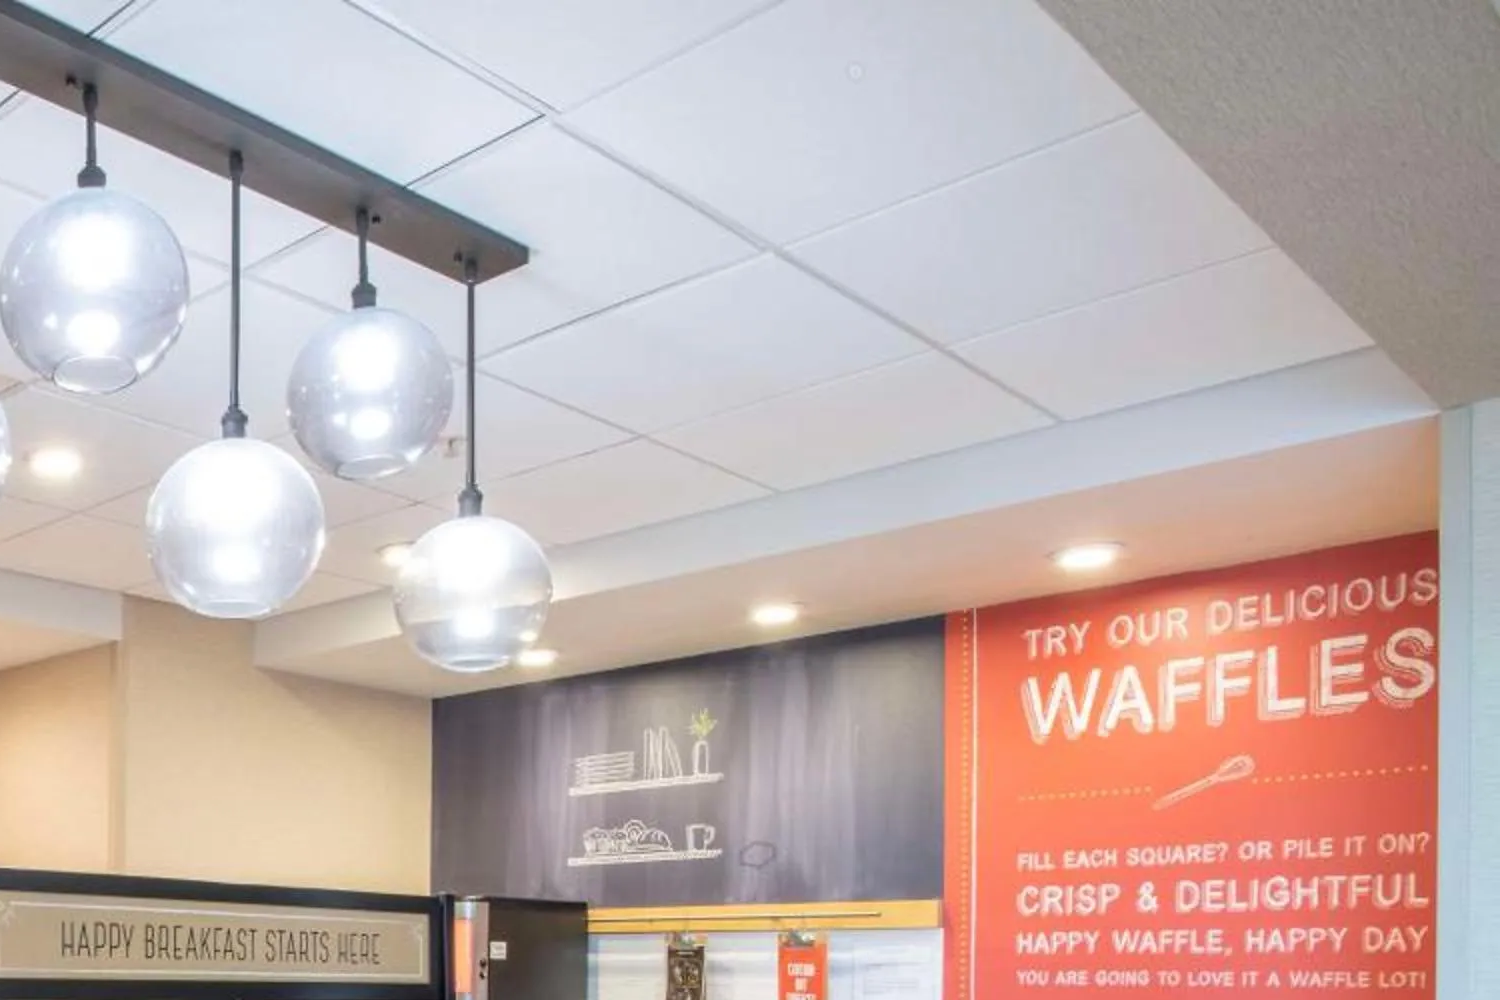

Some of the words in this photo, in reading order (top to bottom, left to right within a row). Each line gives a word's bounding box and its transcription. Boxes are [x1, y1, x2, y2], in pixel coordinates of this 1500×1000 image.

[1020, 620, 1092, 661] TRY
[1107, 606, 1189, 649] OUR
[1205, 567, 1438, 636] DELICIOUS
[1020, 627, 1436, 746] WAFFLES
[1016, 852, 1056, 872] FILL
[1062, 848, 1118, 868] EACH
[1126, 842, 1229, 867] SQUARE?
[1238, 840, 1273, 861] OR
[1283, 836, 1333, 859] PILE
[1344, 835, 1367, 856] IT
[1378, 831, 1430, 855] ON?
[1016, 883, 1121, 917] CRISP
[1135, 880, 1159, 914] &
[1175, 872, 1430, 914] DELIGHTFUL
[61, 921, 135, 959] HAPPY
[144, 922, 258, 961] BREAKFAST
[265, 929, 330, 963] STARTS
[337, 932, 381, 965] HERE
[1016, 930, 1100, 954] HAPPY
[1112, 927, 1233, 957] WAFFLE,
[1244, 927, 1348, 954] HAPPY
[1362, 925, 1429, 954] DAY
[1016, 970, 1049, 986] YOU
[1055, 970, 1088, 986] ARE
[1095, 970, 1150, 986] GOING
[1158, 970, 1181, 986] TO
[1188, 971, 1235, 987] LOVE
[1242, 971, 1258, 988] IT
[1266, 971, 1281, 988] A
[1289, 971, 1371, 988] WAFFLE
[1378, 971, 1427, 988] LOT!
